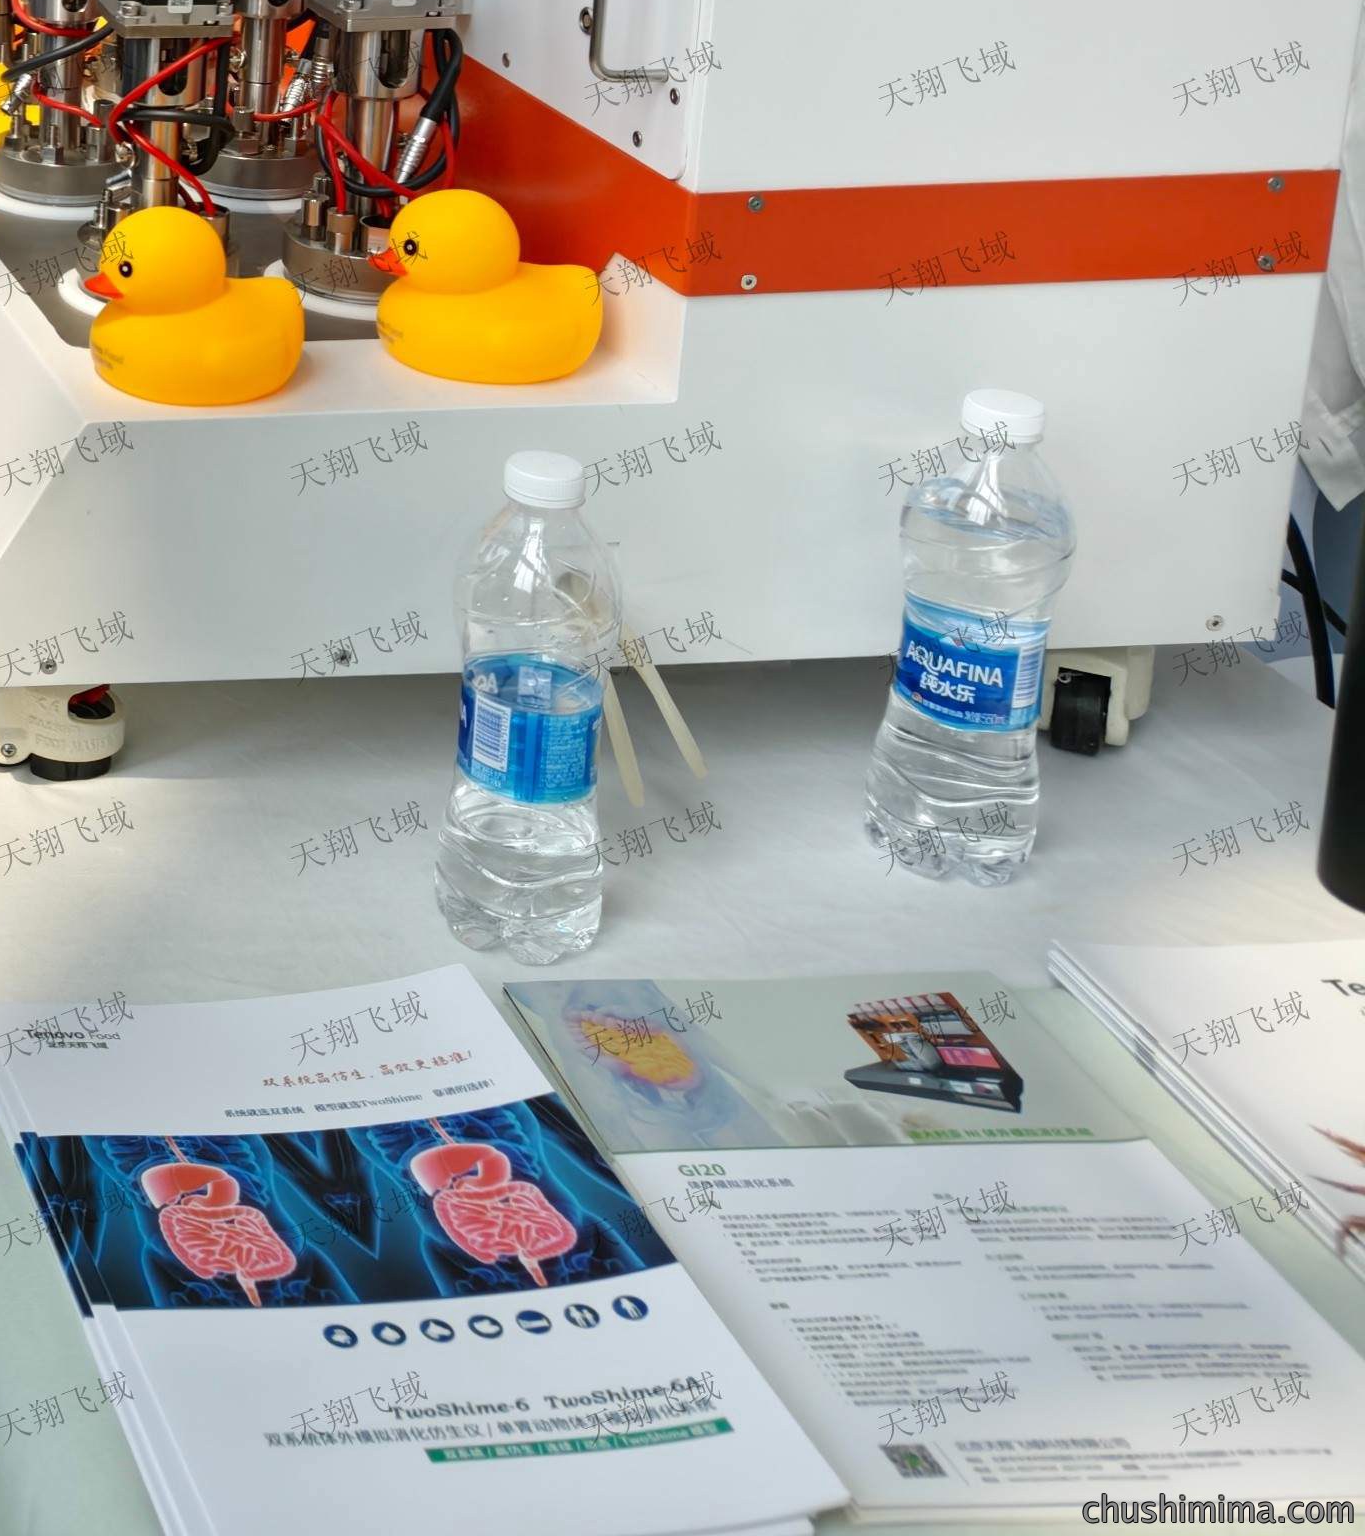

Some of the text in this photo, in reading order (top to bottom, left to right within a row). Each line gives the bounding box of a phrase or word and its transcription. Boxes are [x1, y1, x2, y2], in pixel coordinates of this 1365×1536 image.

[906, 639, 1004, 689] AQUAFINA
[919, 671, 977, 705] 纯水乐
[677, 1162, 728, 1178] GI20
